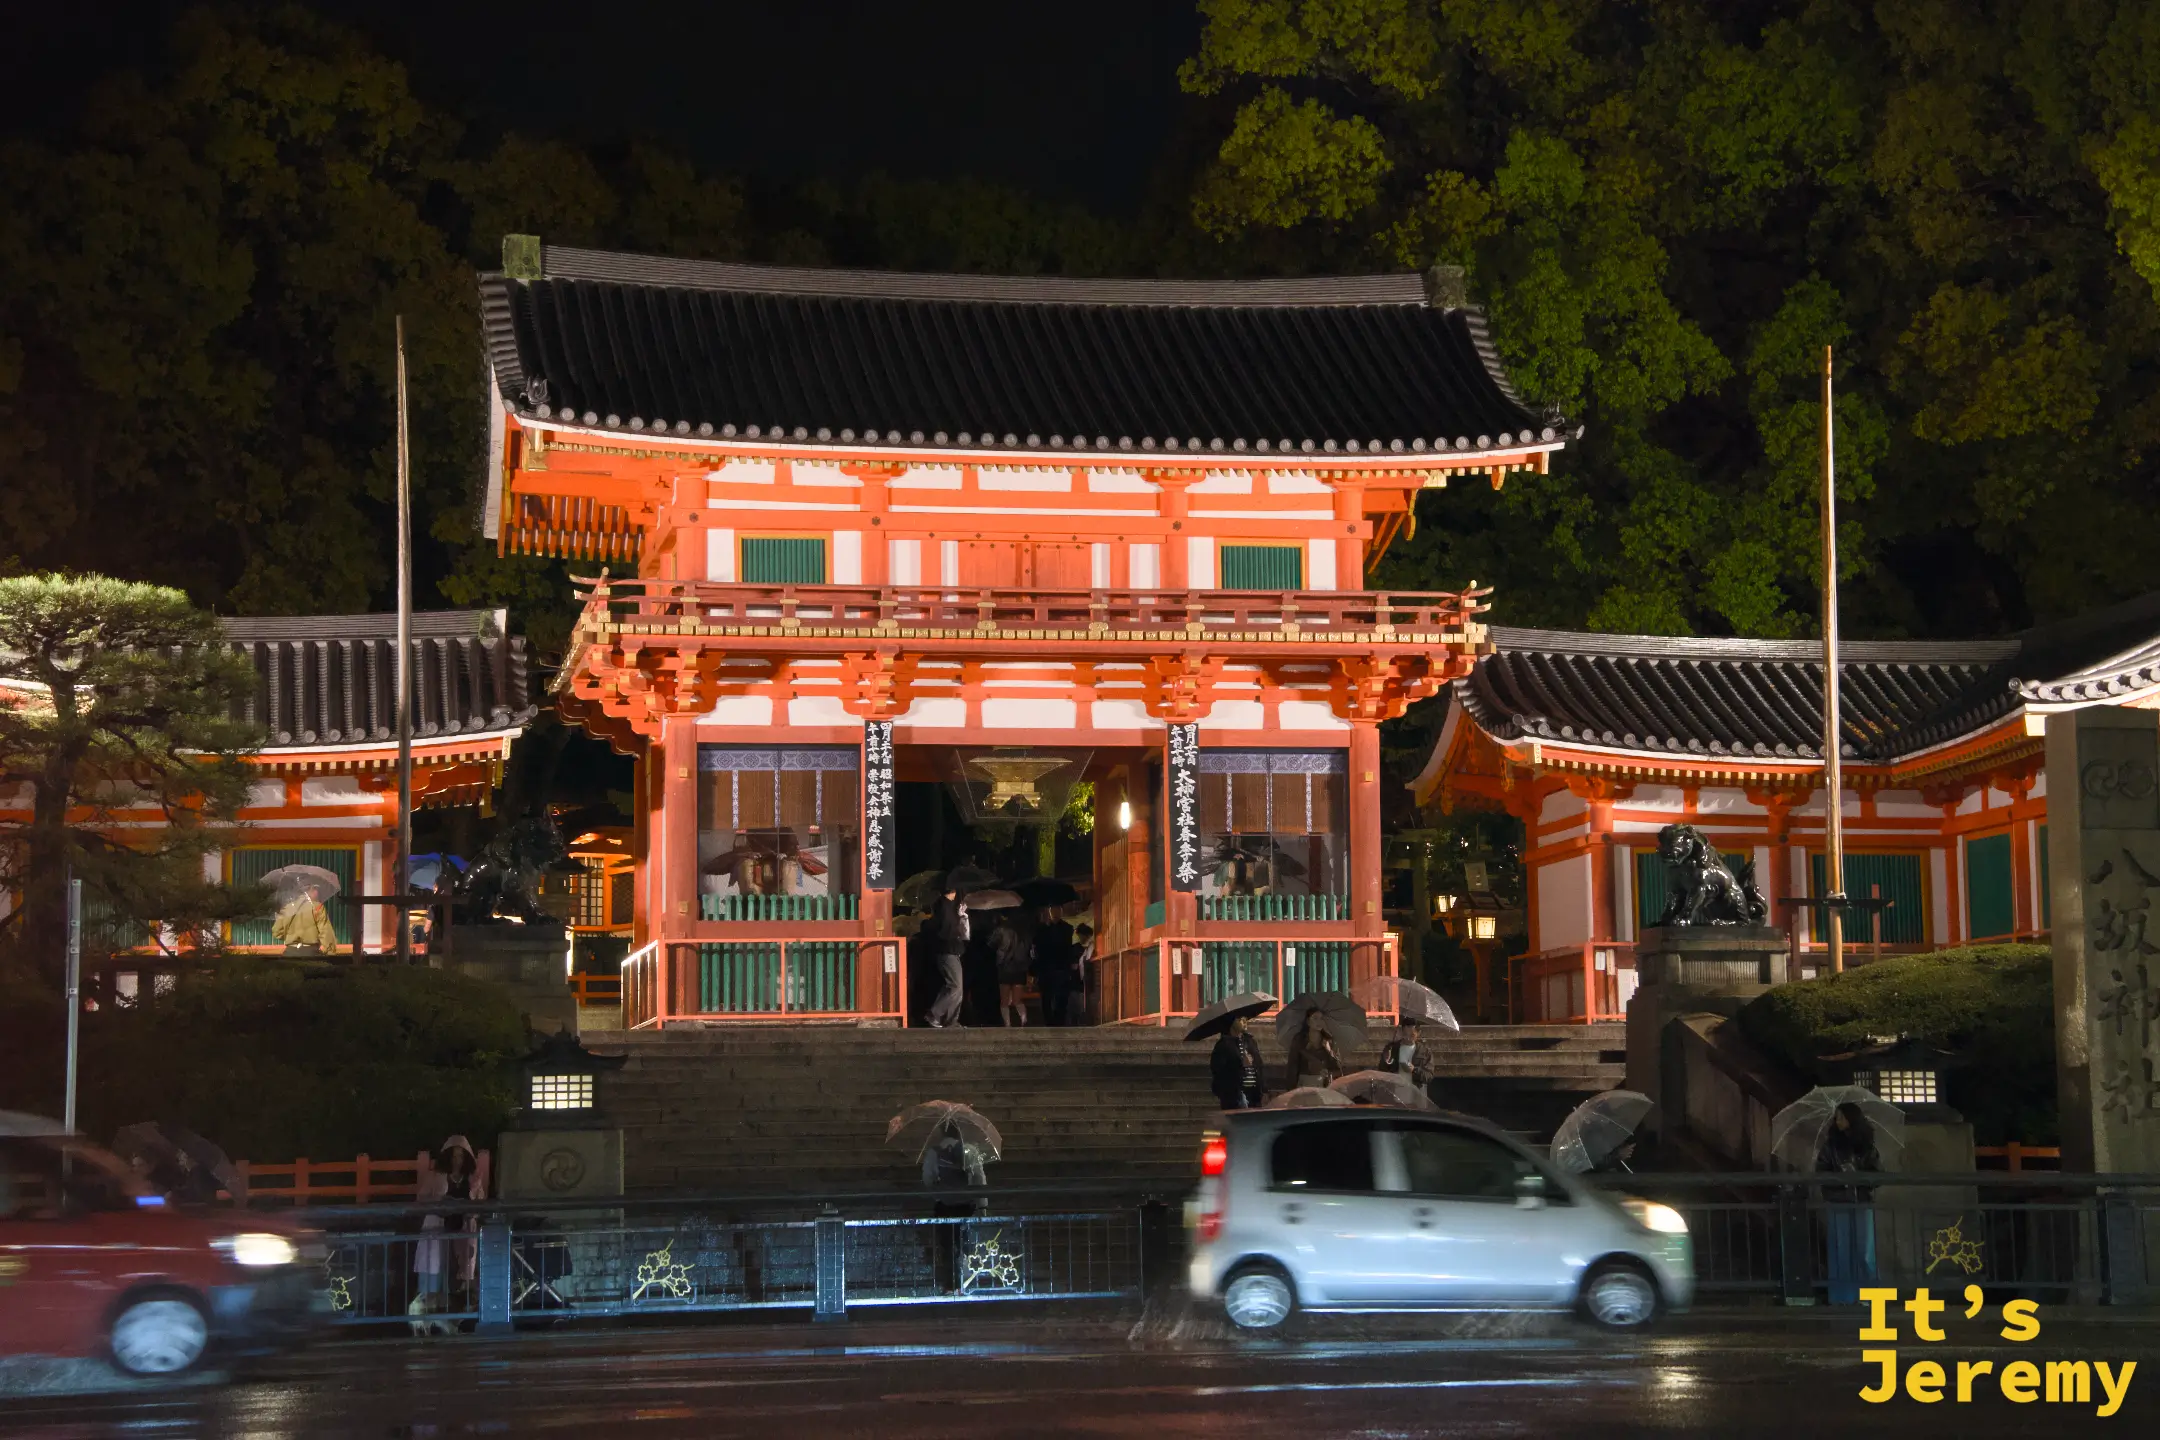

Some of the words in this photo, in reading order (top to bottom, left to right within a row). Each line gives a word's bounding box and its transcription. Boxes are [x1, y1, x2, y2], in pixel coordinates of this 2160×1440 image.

[867, 722, 880, 764] 午前十時
[1170, 725, 1185, 767] 午前十時
[1174, 769, 1197, 884] 大神宮社春季祭
[2086, 847, 2160, 1125] 八坂神社
